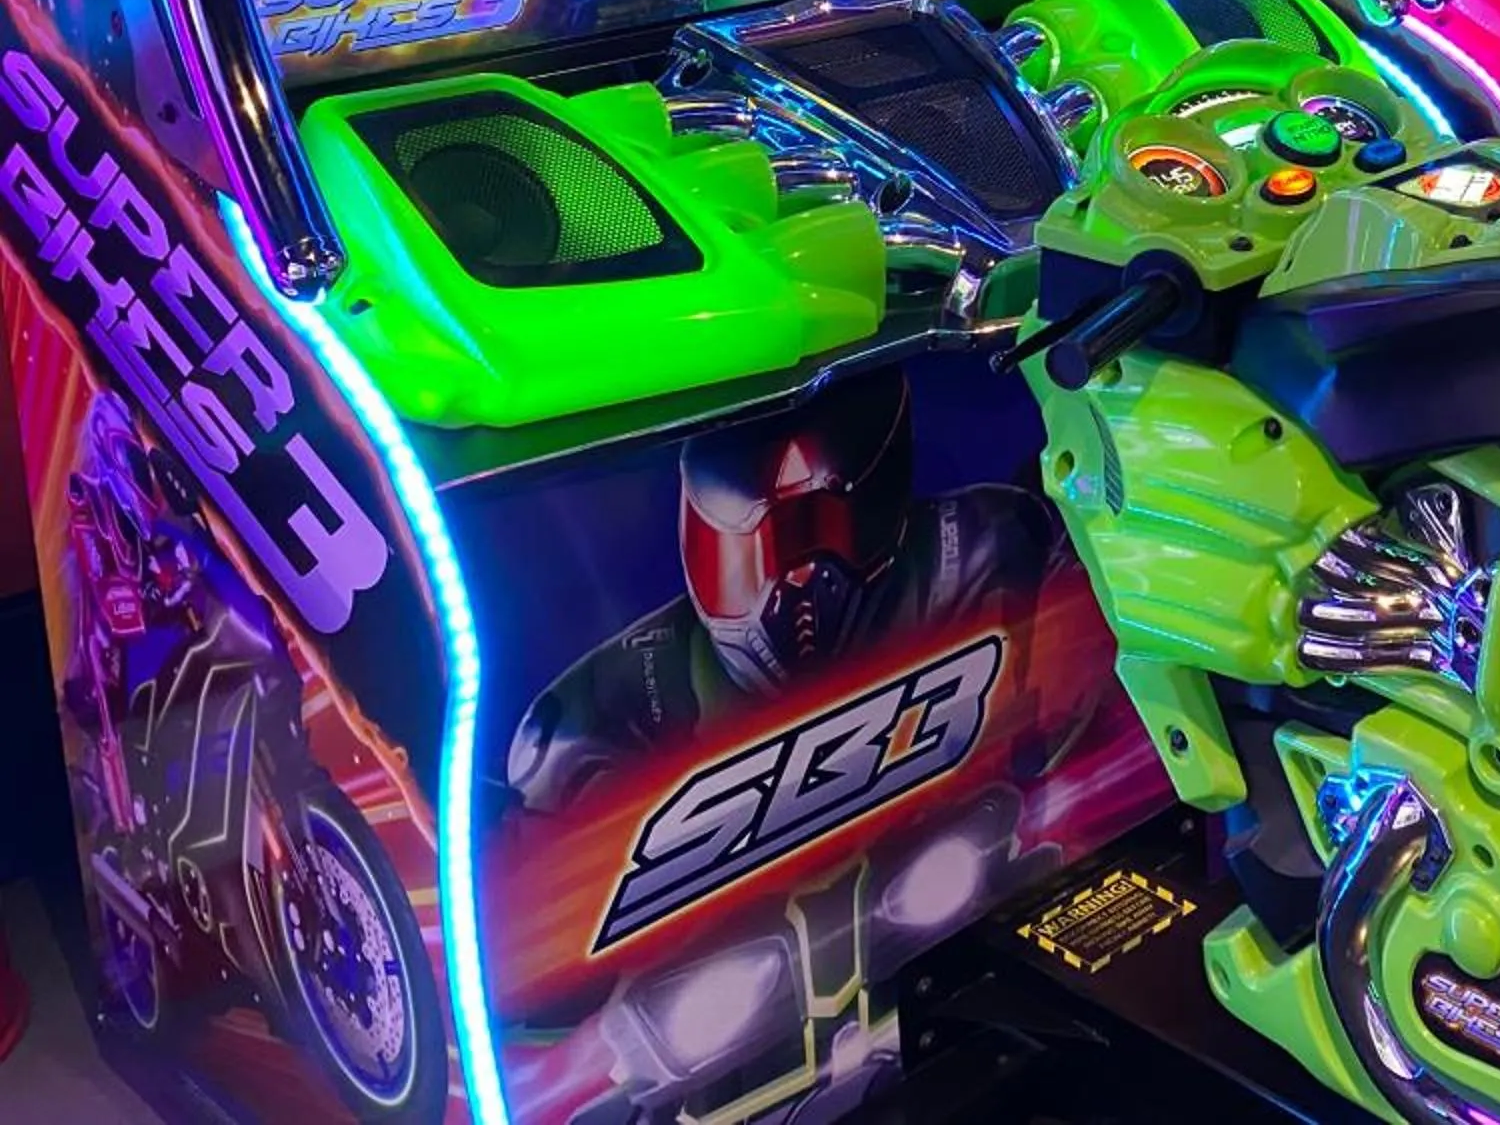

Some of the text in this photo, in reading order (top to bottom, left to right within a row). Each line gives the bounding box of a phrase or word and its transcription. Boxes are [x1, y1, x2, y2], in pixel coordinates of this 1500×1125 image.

[0, 143, 257, 476] BIKES
[1, 49, 295, 433] SUPER
[591, 635, 1003, 955] SB3
[1037, 879, 1137, 937] WARNING!
